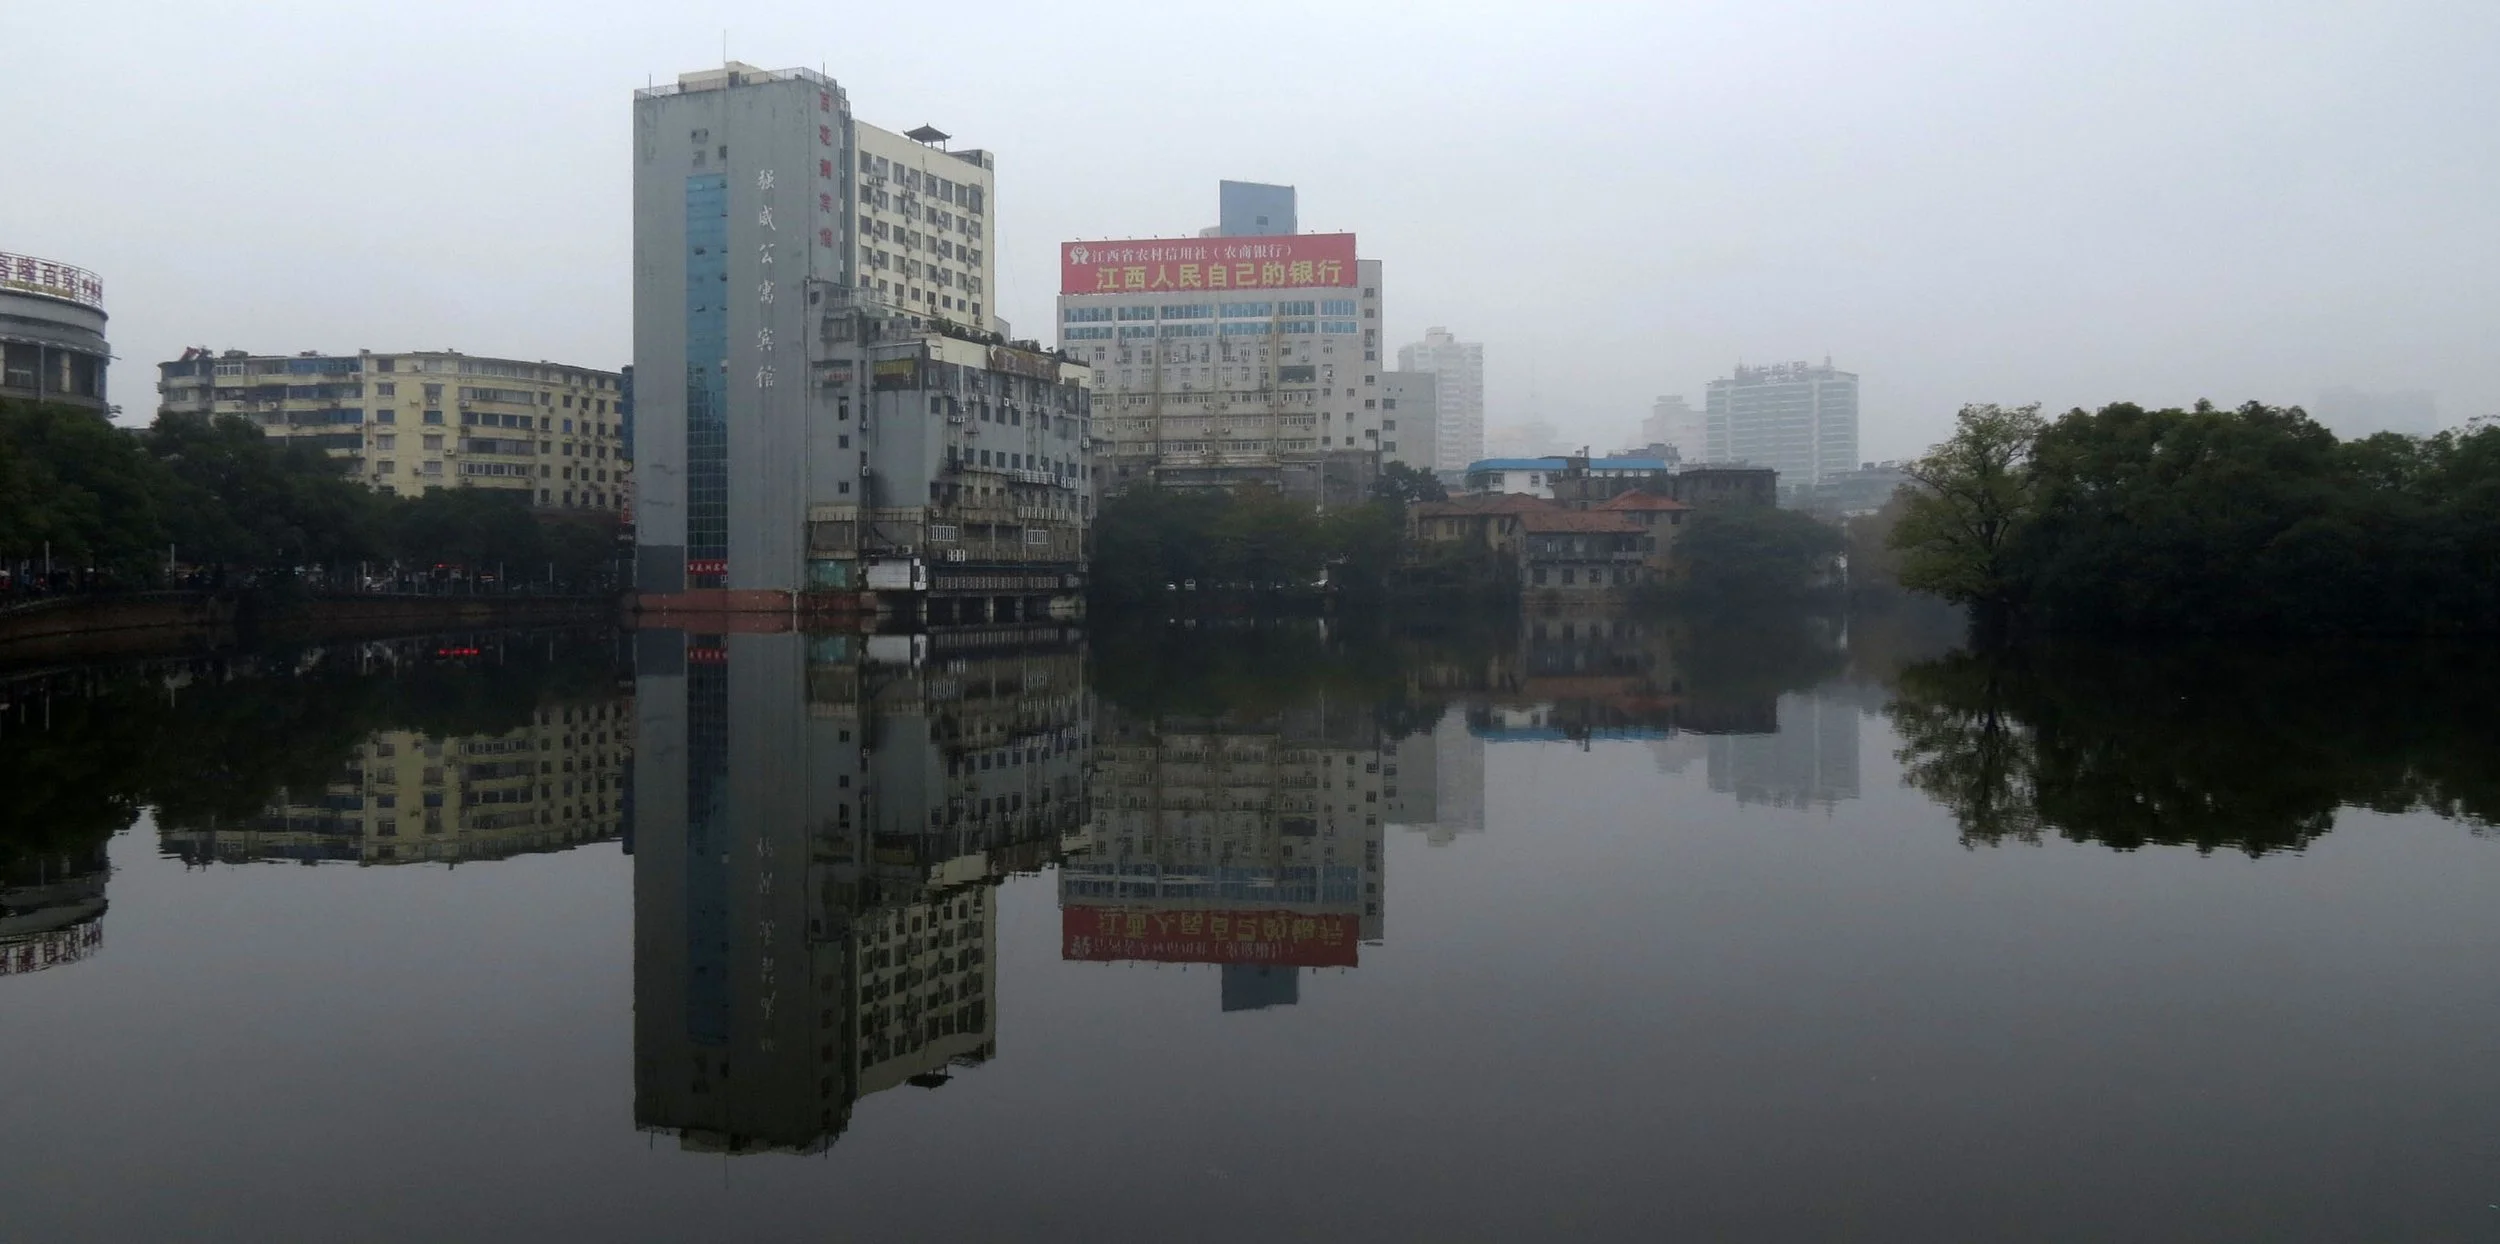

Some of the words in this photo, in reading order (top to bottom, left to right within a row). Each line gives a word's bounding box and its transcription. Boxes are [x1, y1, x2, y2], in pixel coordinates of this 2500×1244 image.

[1096, 259, 1344, 290] 江西人民自己的银行
